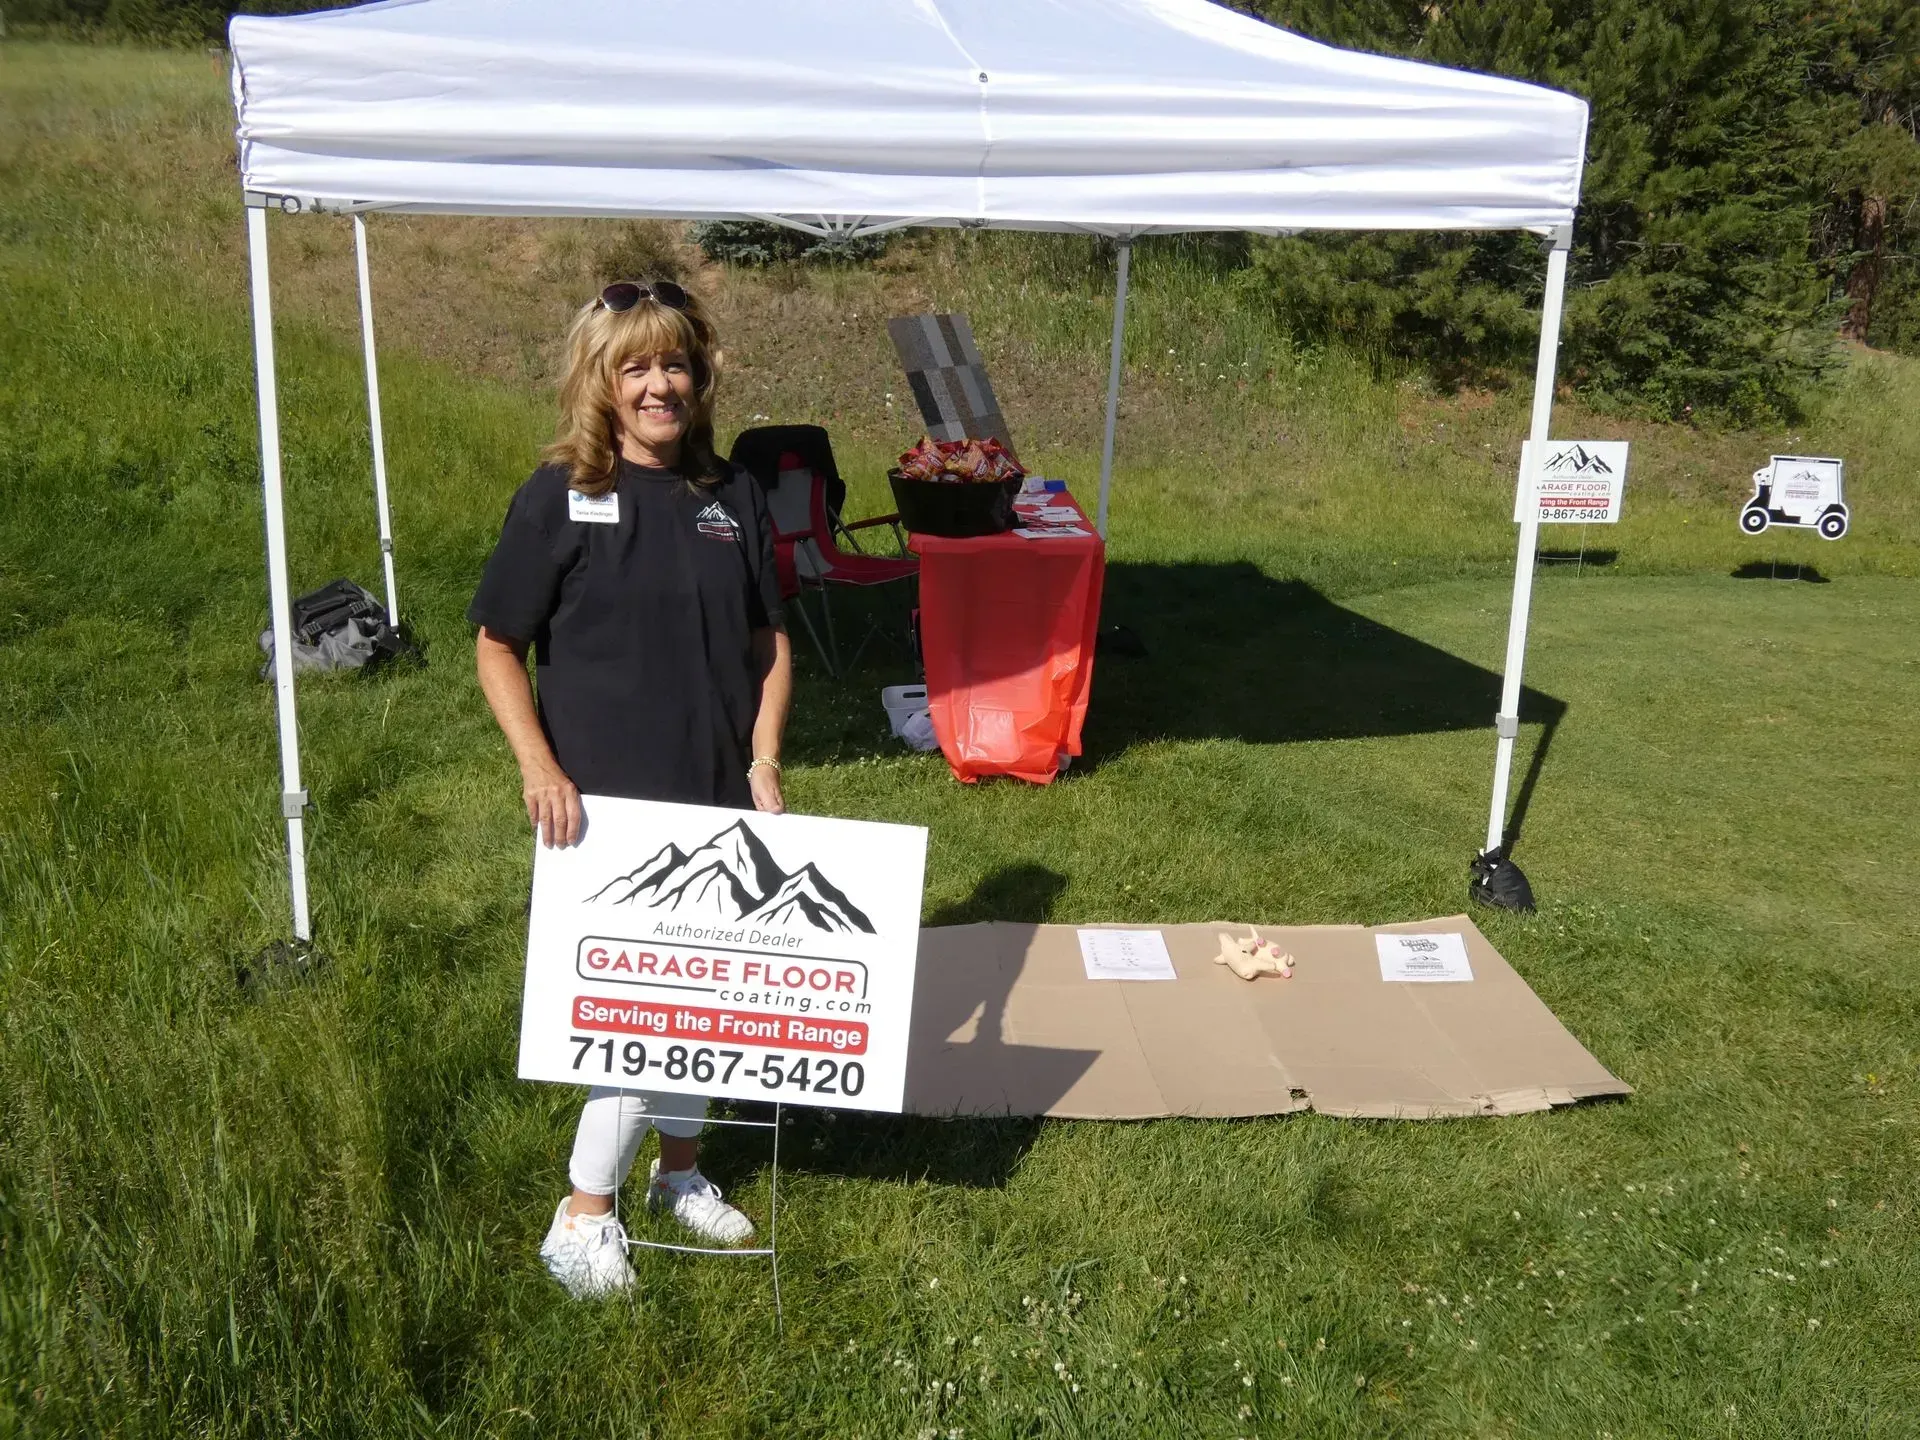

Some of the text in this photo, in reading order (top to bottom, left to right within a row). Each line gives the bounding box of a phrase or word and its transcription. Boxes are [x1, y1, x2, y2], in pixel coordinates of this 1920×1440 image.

[1538, 509, 1608, 519] 9-867-5420
[653, 921, 804, 949] Authorized Dealer
[587, 947, 856, 994] GARAGE FLOOR
[719, 988, 872, 1015] coating.com
[578, 1001, 862, 1050] Serving the Front Range
[569, 1035, 865, 1097] 719-867-5420
